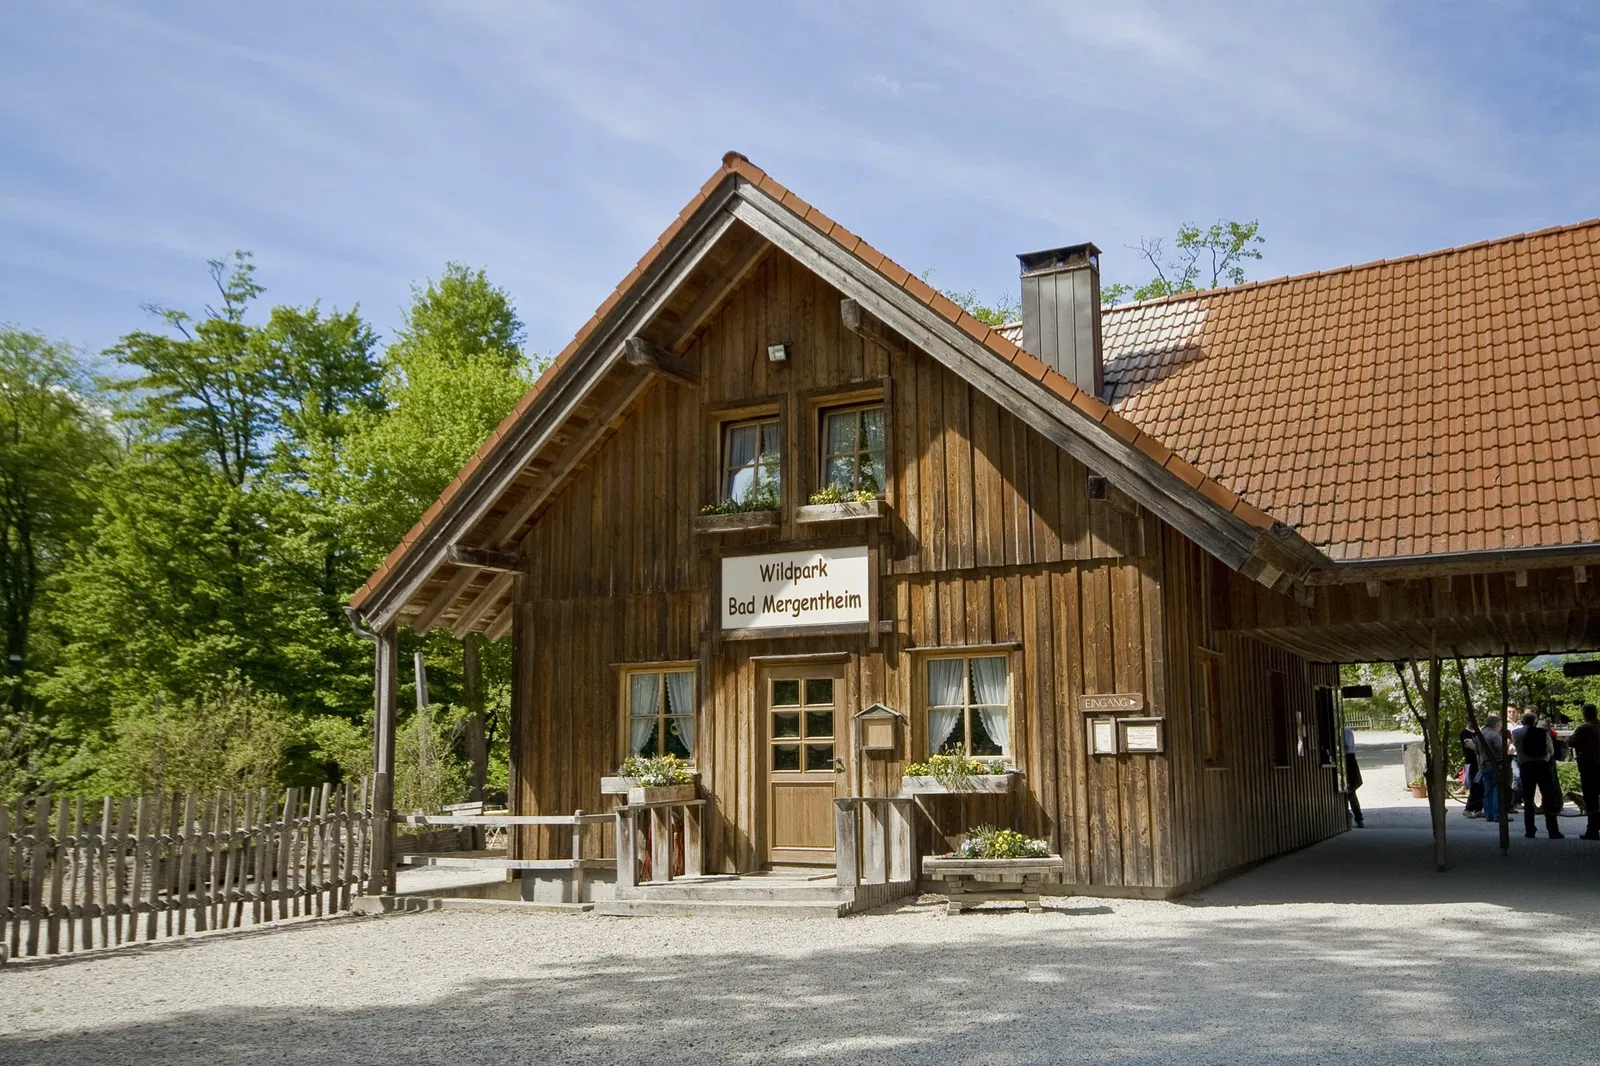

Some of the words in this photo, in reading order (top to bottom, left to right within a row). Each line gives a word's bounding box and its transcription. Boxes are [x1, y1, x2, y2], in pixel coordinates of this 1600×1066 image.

[760, 558, 828, 586] Wildpark
[728, 595, 756, 616] Bad
[762, 590, 862, 618] Mergentheim
